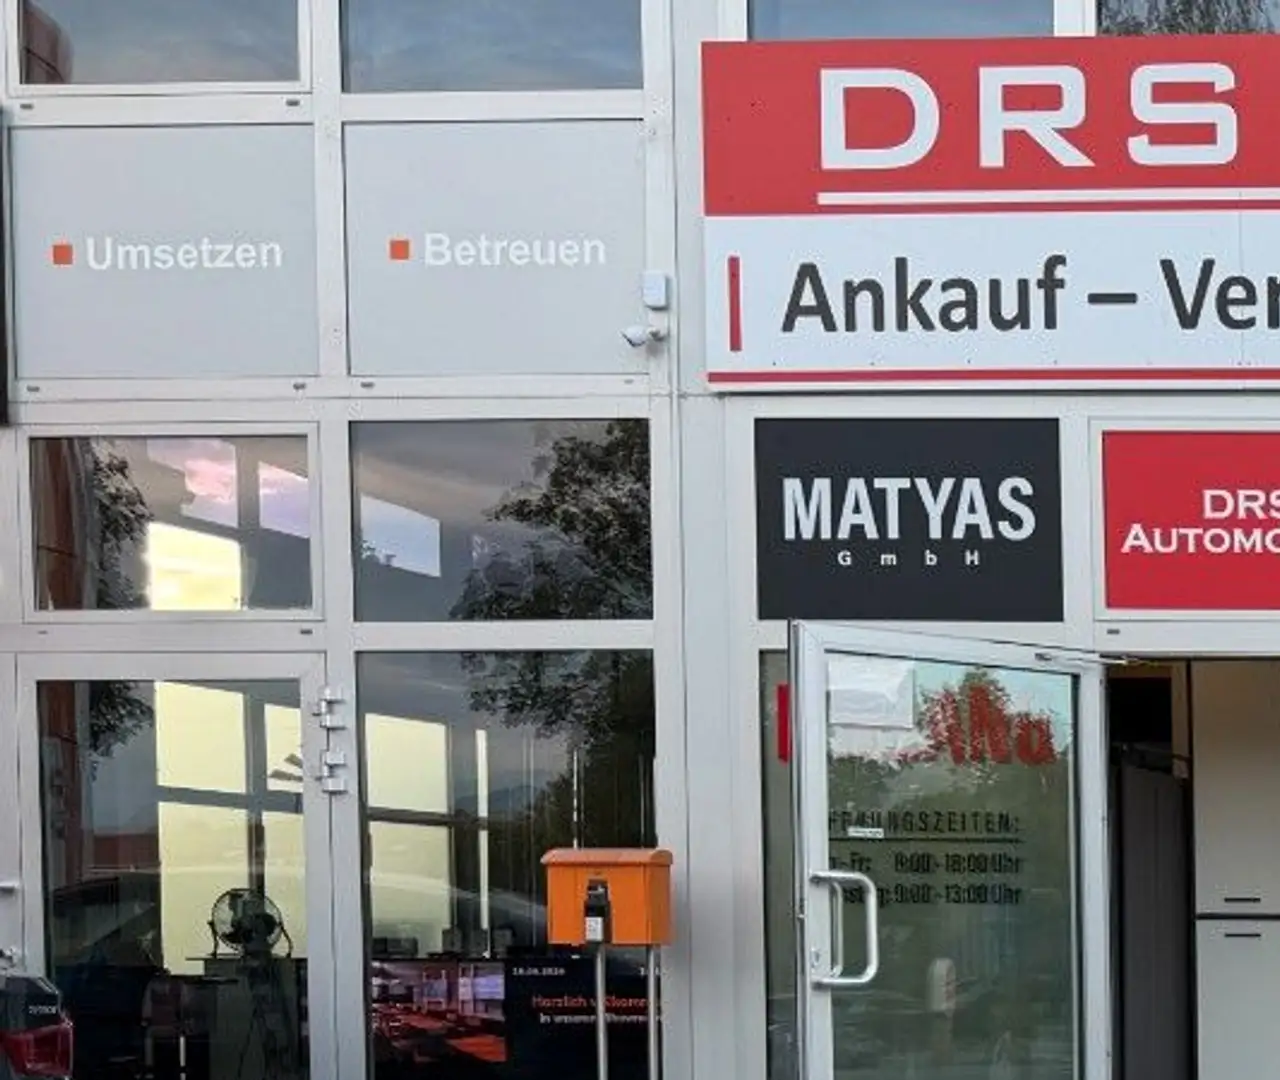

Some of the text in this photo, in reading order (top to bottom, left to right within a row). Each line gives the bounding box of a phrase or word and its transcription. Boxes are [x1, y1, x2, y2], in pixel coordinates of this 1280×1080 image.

[819, 62, 1240, 170] DRS
[85, 236, 283, 270] Umsetzen
[424, 232, 606, 266] Betreuen
[781, 254, 1067, 333] Ankauf
[783, 476, 1036, 541] MATYAS
